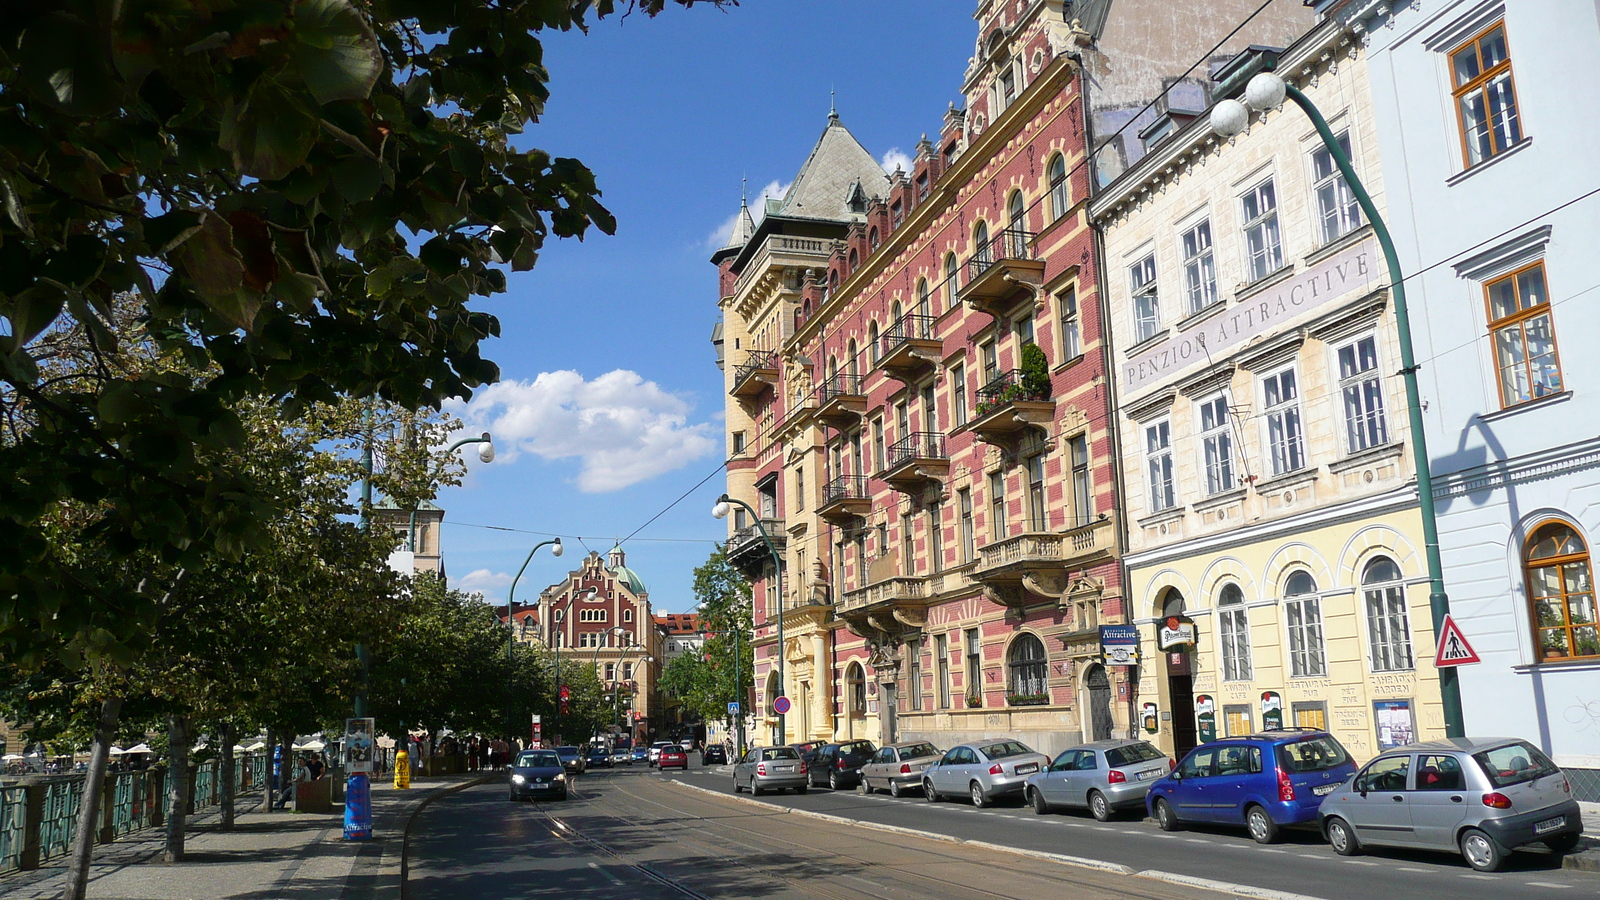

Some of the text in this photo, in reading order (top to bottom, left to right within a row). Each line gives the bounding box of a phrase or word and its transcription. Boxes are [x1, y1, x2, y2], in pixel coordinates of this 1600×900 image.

[1127, 252, 1369, 385] PENZION ATTRACTIVE
[1102, 629, 1136, 639] Attractive
[1303, 689, 1318, 697] PUB
[1374, 684, 1410, 694] GARDEN
